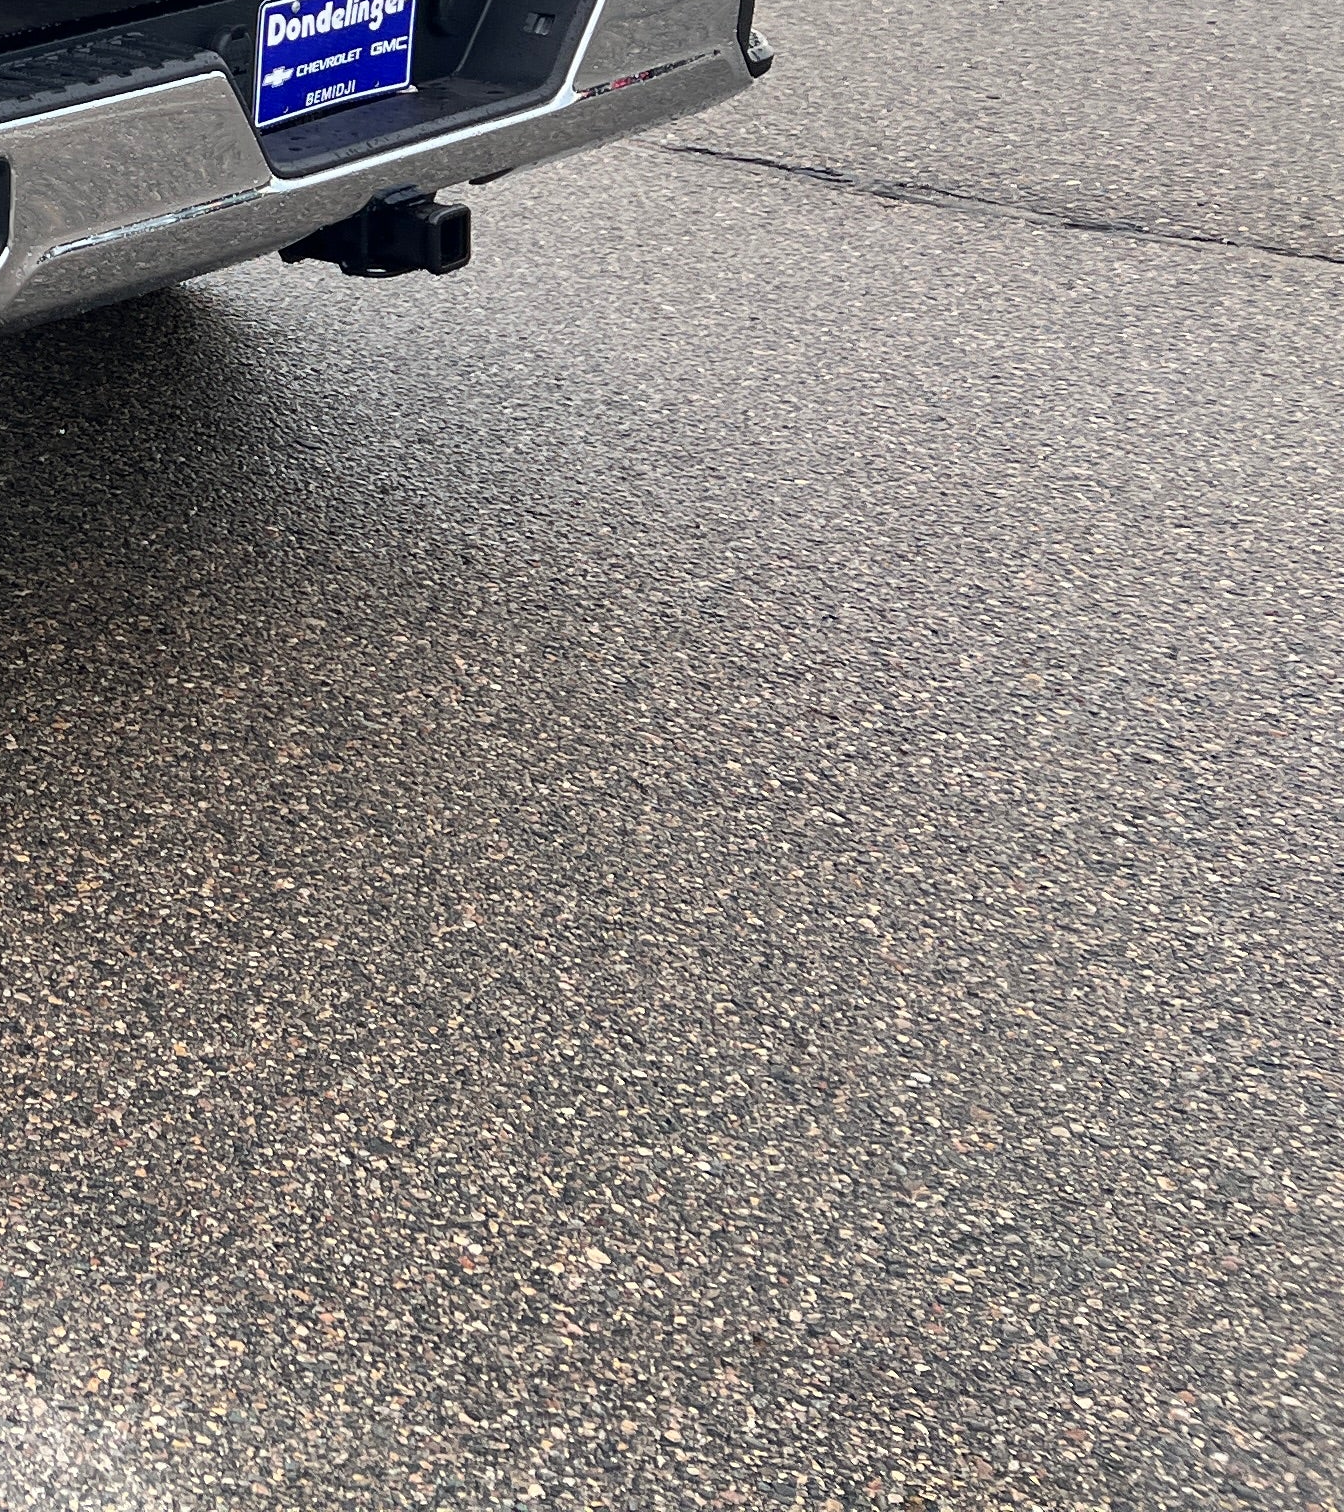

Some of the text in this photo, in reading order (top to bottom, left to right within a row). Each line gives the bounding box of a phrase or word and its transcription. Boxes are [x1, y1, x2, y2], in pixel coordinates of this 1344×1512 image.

[296, 35, 409, 78] CHEVROLET GMC
[305, 79, 356, 107] BEMIDJI
